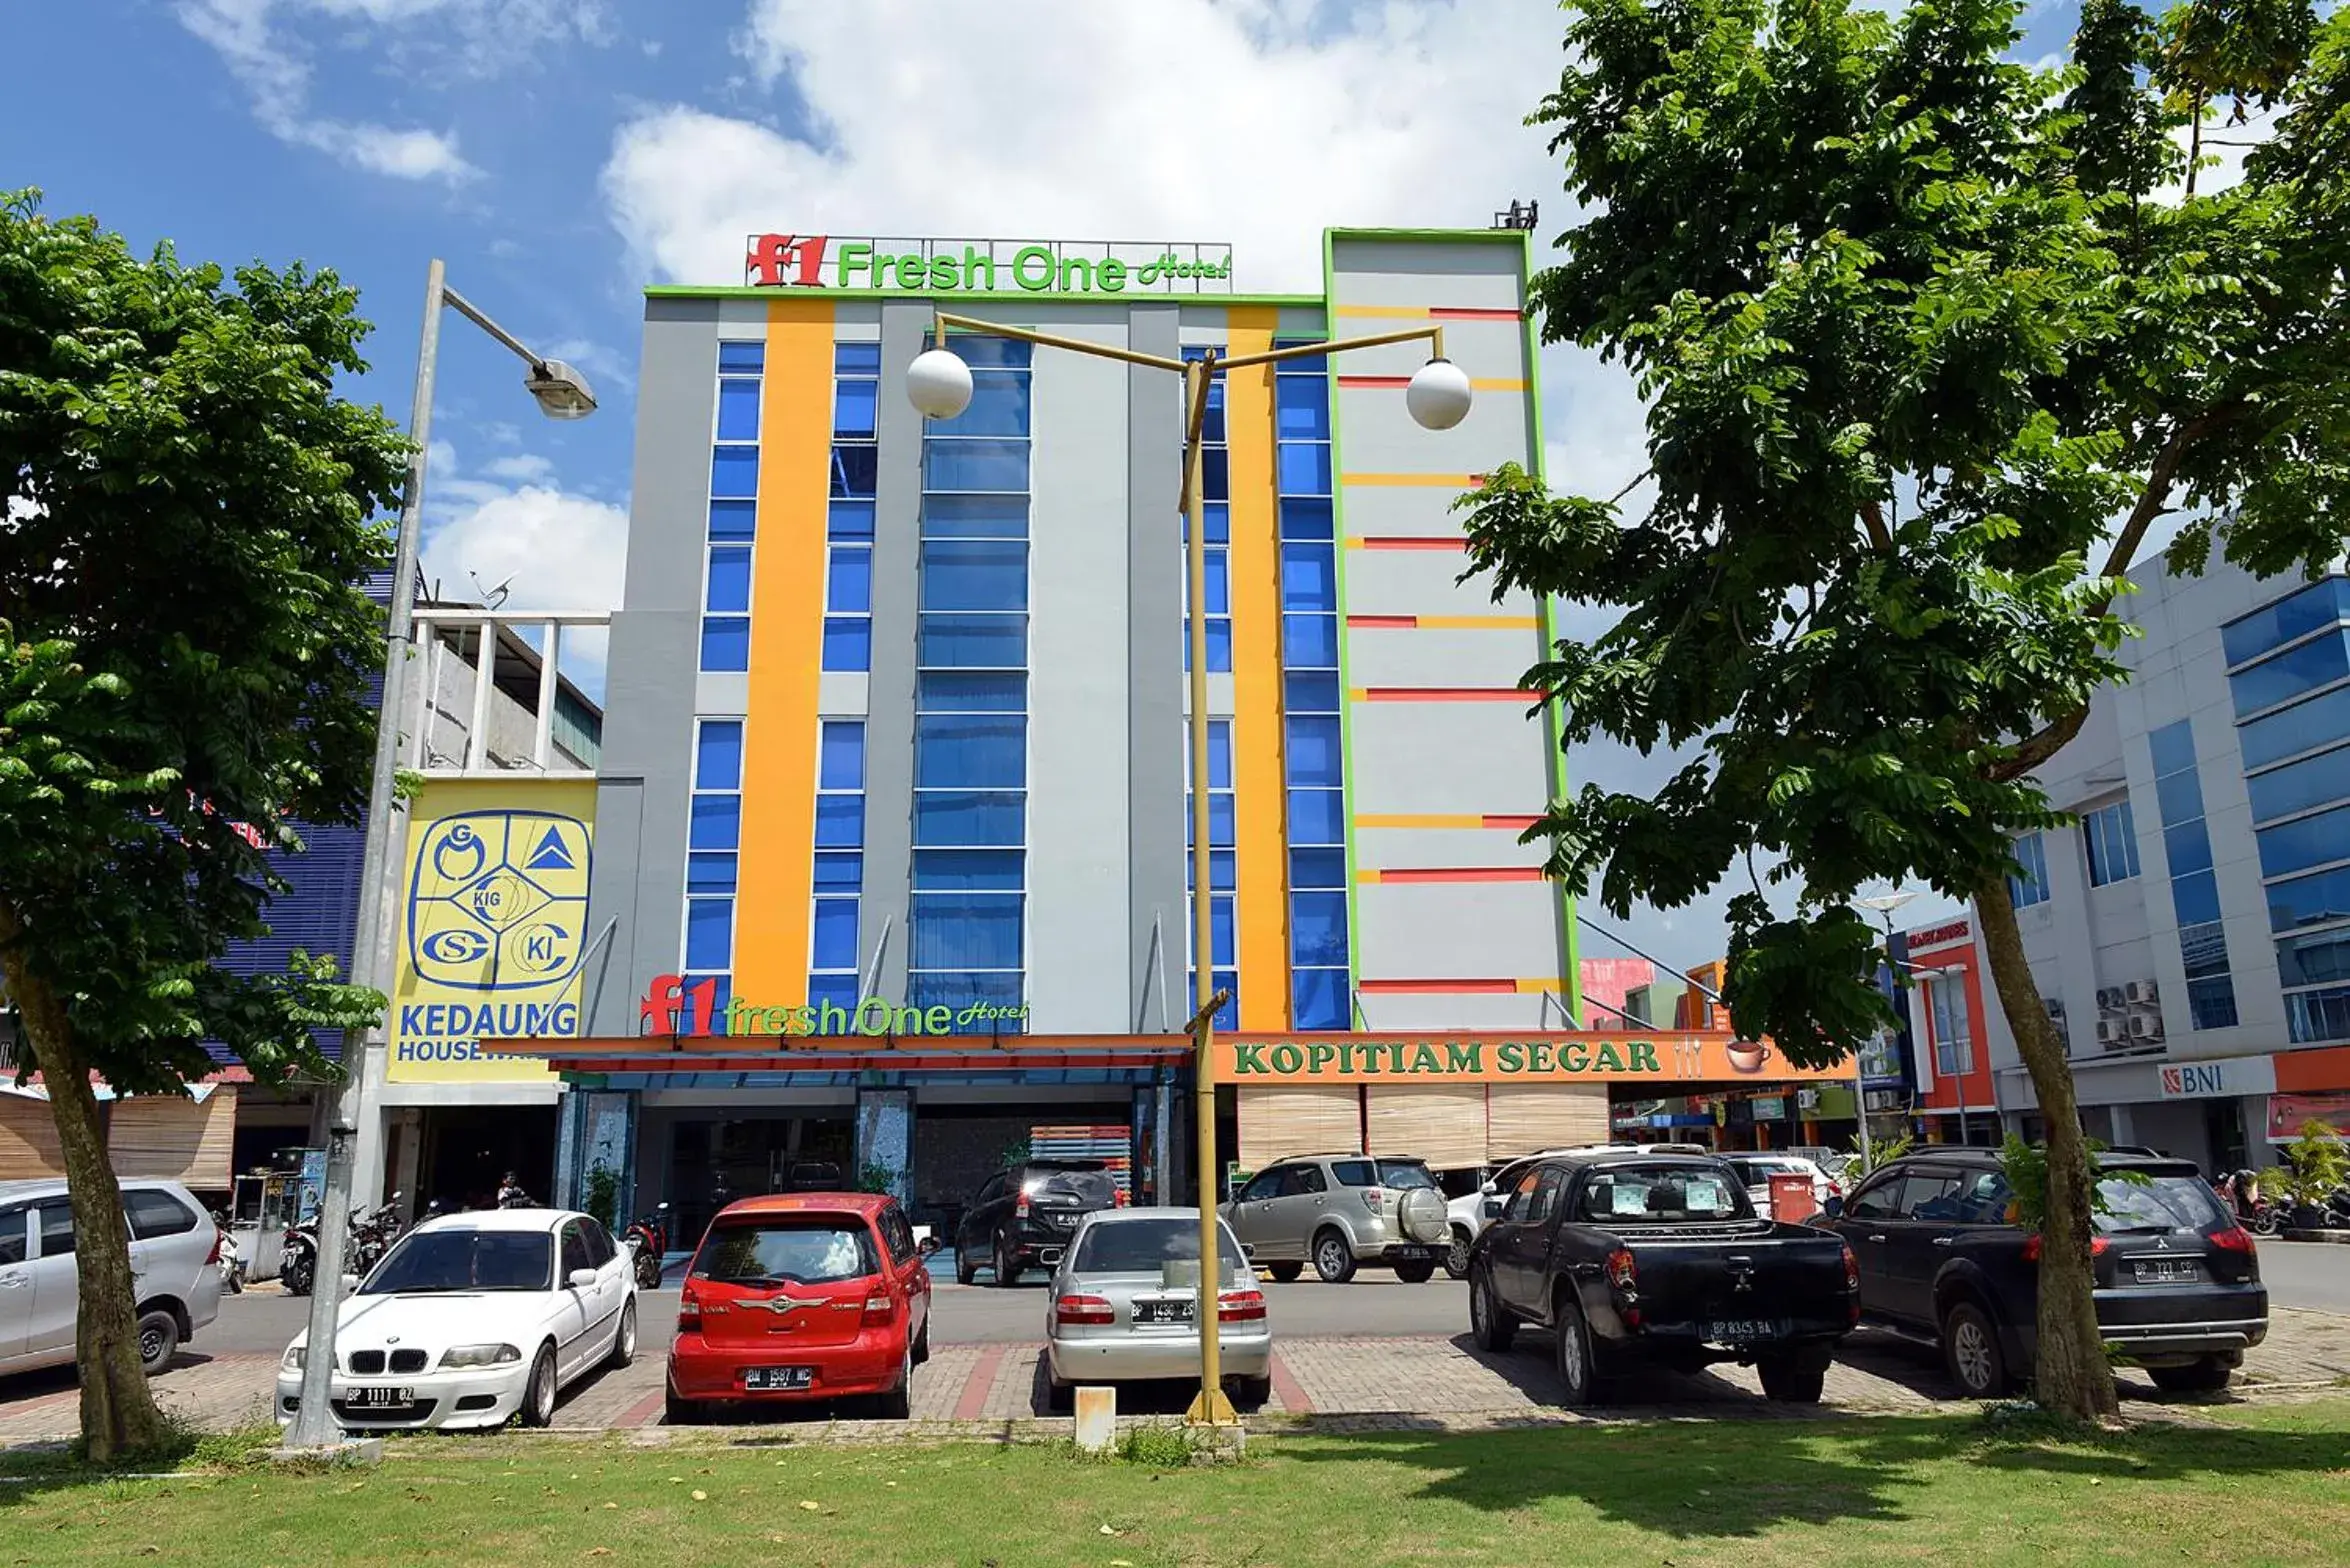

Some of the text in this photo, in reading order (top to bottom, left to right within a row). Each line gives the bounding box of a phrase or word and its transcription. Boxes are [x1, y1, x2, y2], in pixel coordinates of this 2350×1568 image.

[838, 243, 995, 290] Fresh
[1012, 245, 1127, 292] One
[1138, 253, 1232, 283] Hotel
[473, 891, 500, 907] KIG
[400, 1003, 577, 1036] KEDAUNG
[957, 1000, 1031, 1026] Hotel
[397, 1041, 550, 1061] HOUSE
[1234, 1042, 1661, 1074] KOPITIAM SEGAR
[2183, 1065, 2222, 1093] BNI
[367, 1388, 391, 1401] 1111
